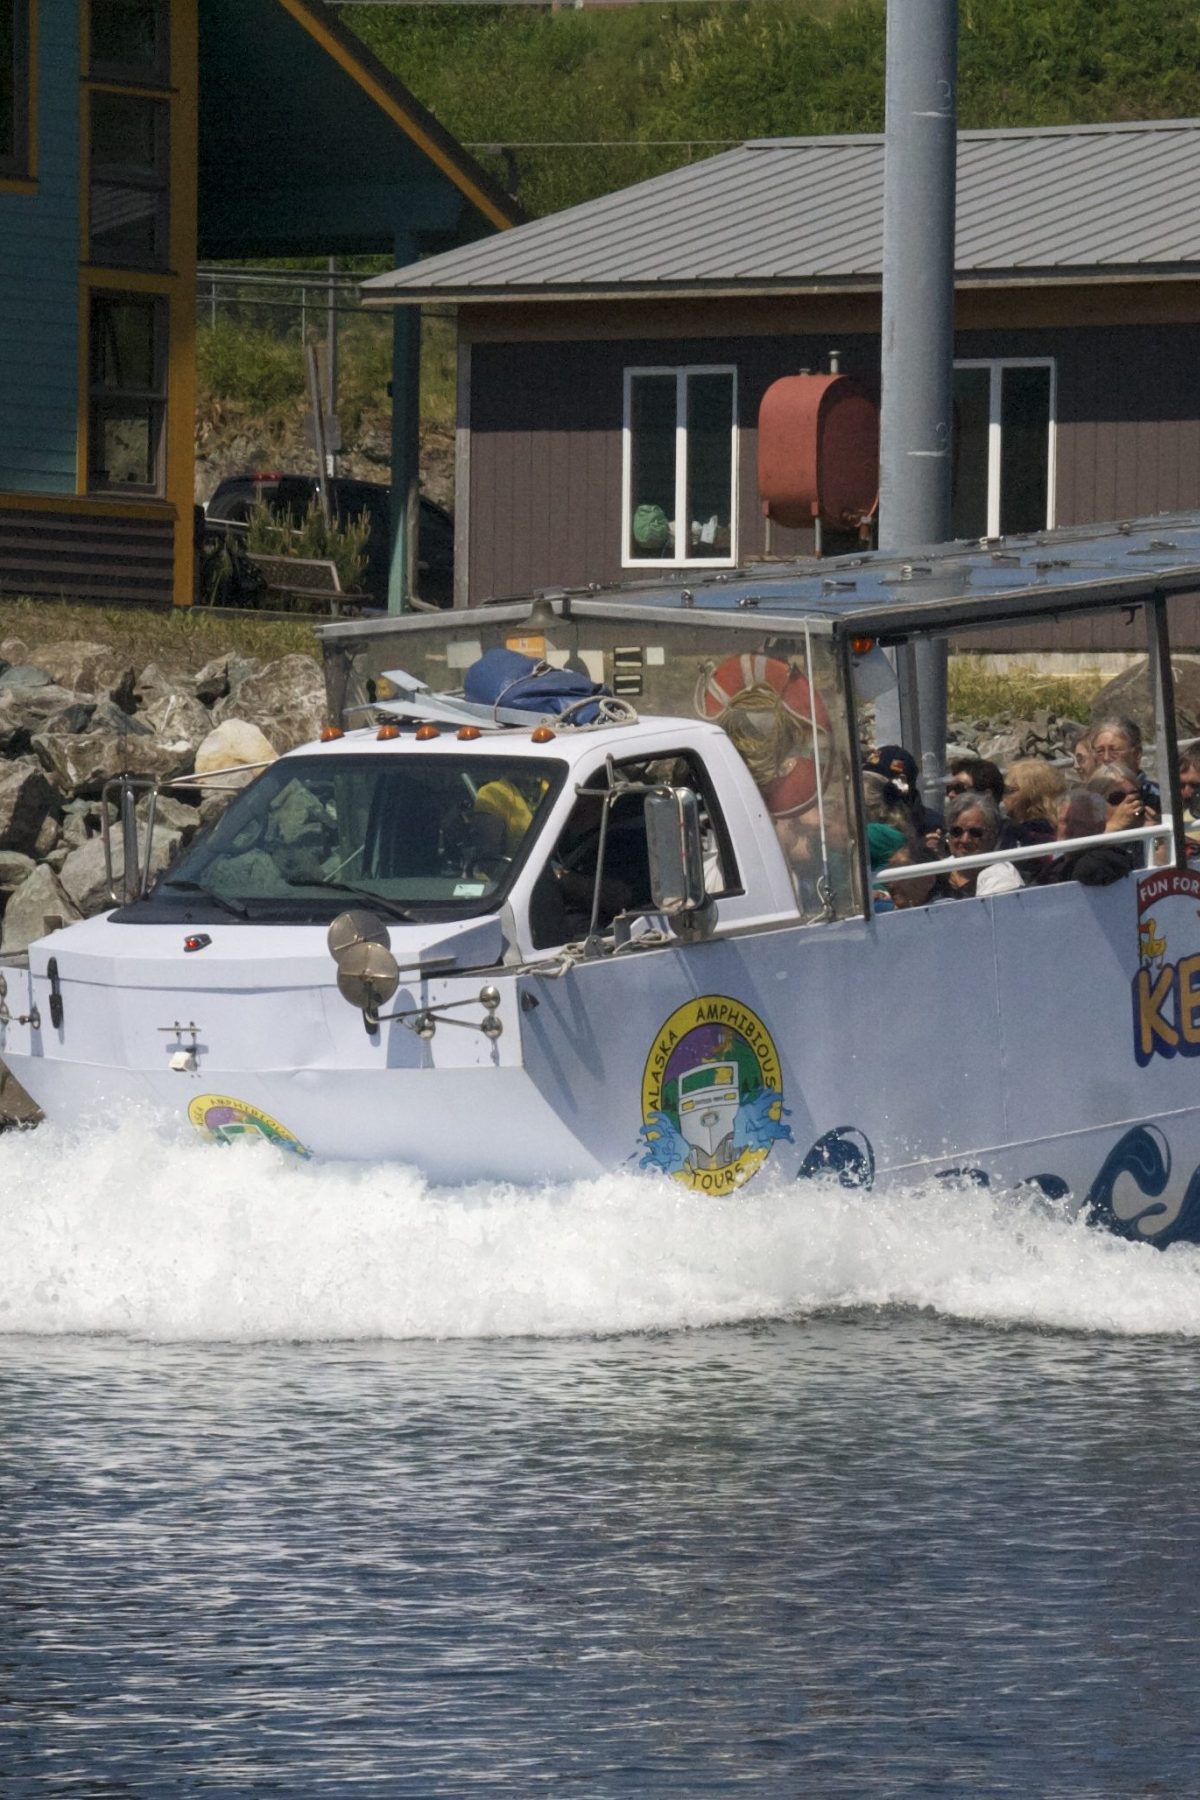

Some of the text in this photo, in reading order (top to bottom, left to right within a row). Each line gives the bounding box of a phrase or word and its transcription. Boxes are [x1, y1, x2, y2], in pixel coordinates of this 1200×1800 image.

[1140, 879, 1168, 902] FUN
[1172, 877, 1200, 894] FOR
[648, 1004, 777, 1111] ALASKA AMPHIBIOUS
